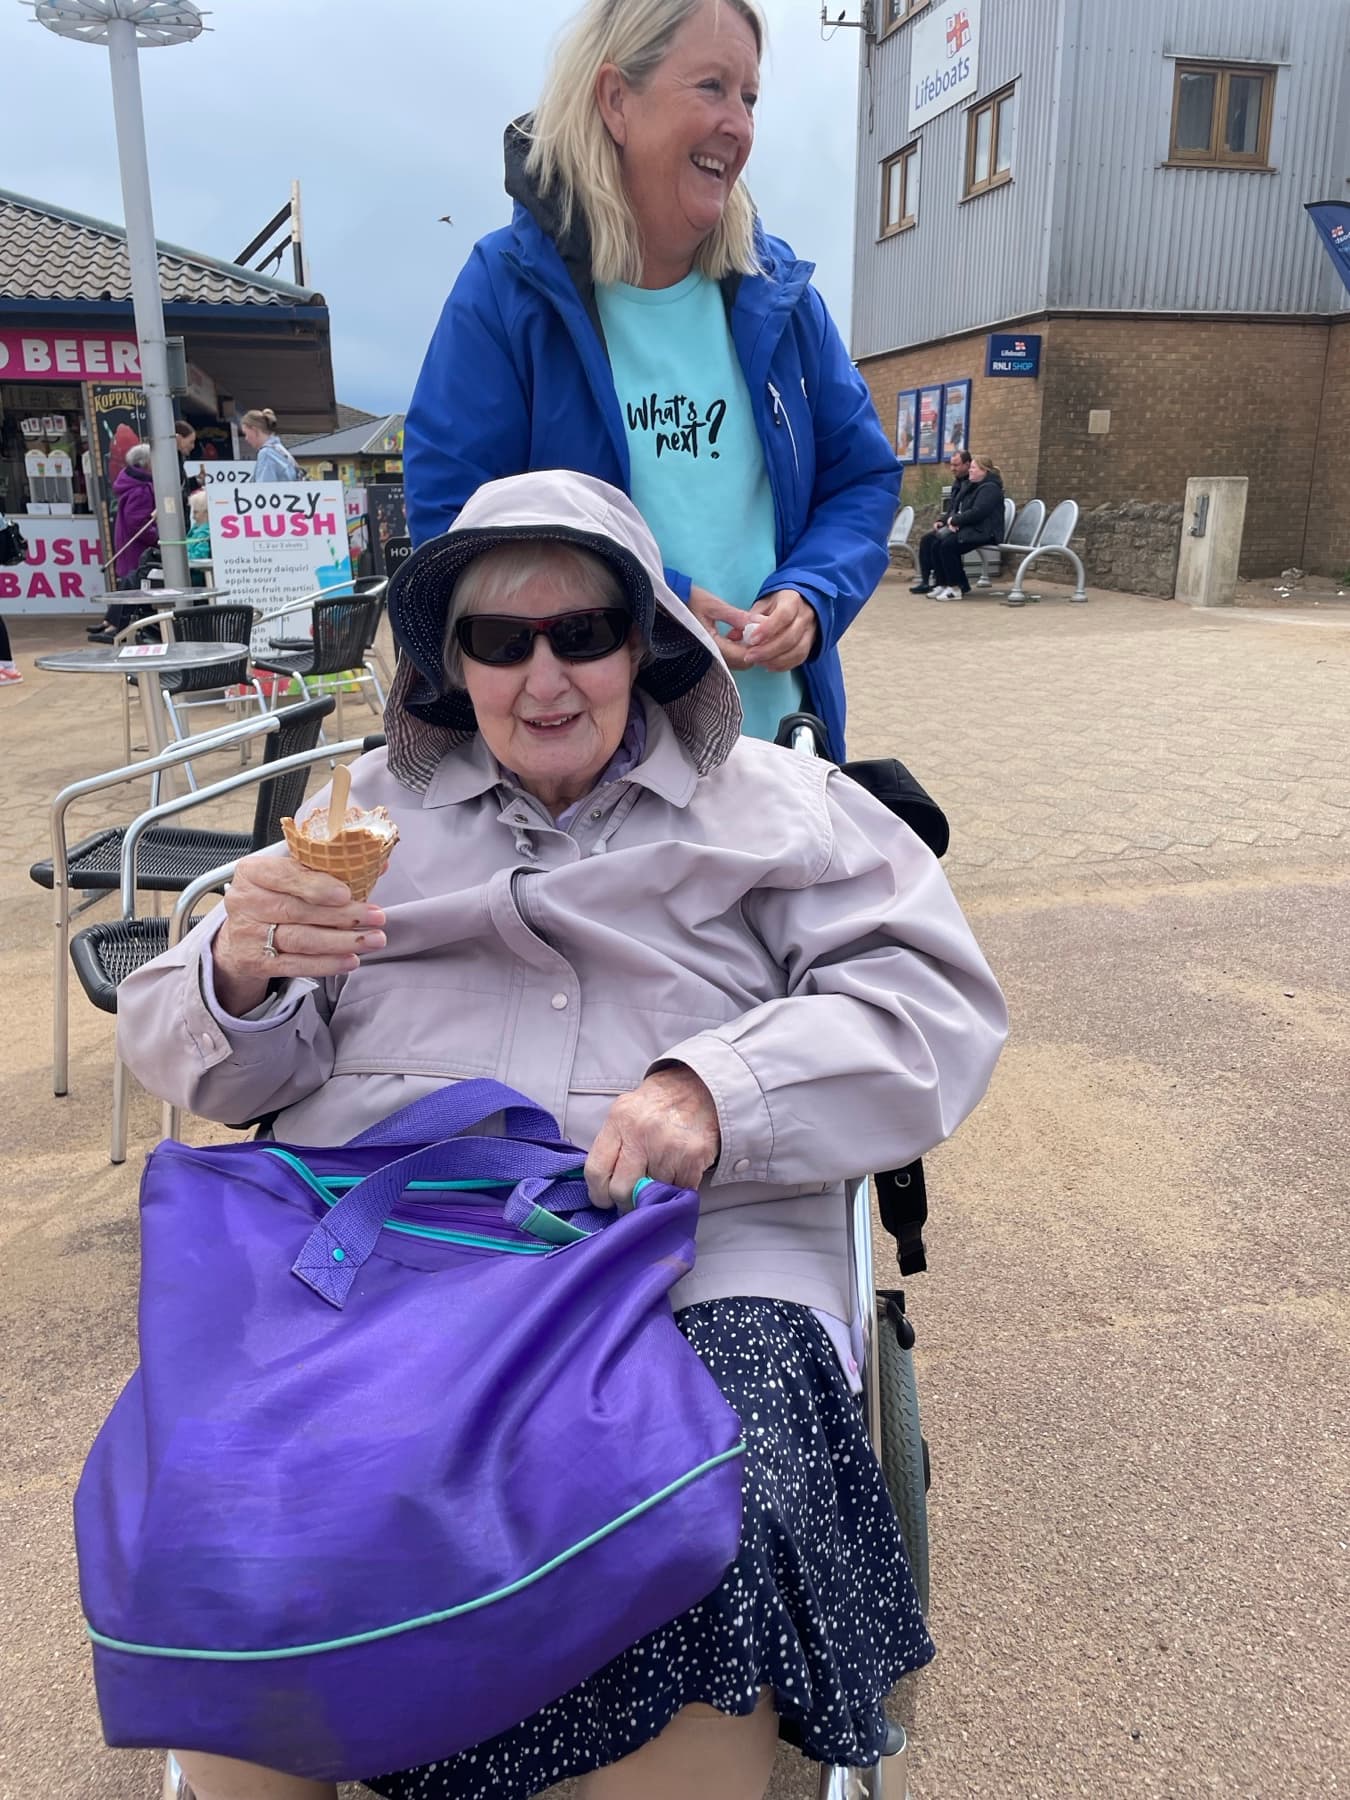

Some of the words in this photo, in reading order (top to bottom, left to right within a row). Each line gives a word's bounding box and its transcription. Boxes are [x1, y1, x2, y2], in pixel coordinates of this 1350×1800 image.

[915, 57, 970, 110] Lifeboats
[992, 361, 1012, 371] RNLI
[1012, 361, 1033, 371] SHOP
[94, 391, 147, 412] KOPPAR
[626, 393, 698, 431] What's
[206, 470, 252, 485] ooz
[233, 487, 321, 520] boozy
[220, 512, 337, 539] SLUSH
[24, 538, 105, 566] USH
[224, 556, 251, 565] vodka
[253, 556, 273, 564] blue
[224, 566, 272, 575] strawberry
[274, 564, 309, 574] daiquiri
[0, 572, 86, 598] BAR
[225, 577, 251, 586] apple
[229, 586, 260, 595] assion
[262, 585, 280, 594] fruit
[283, 584, 315, 593] martini
